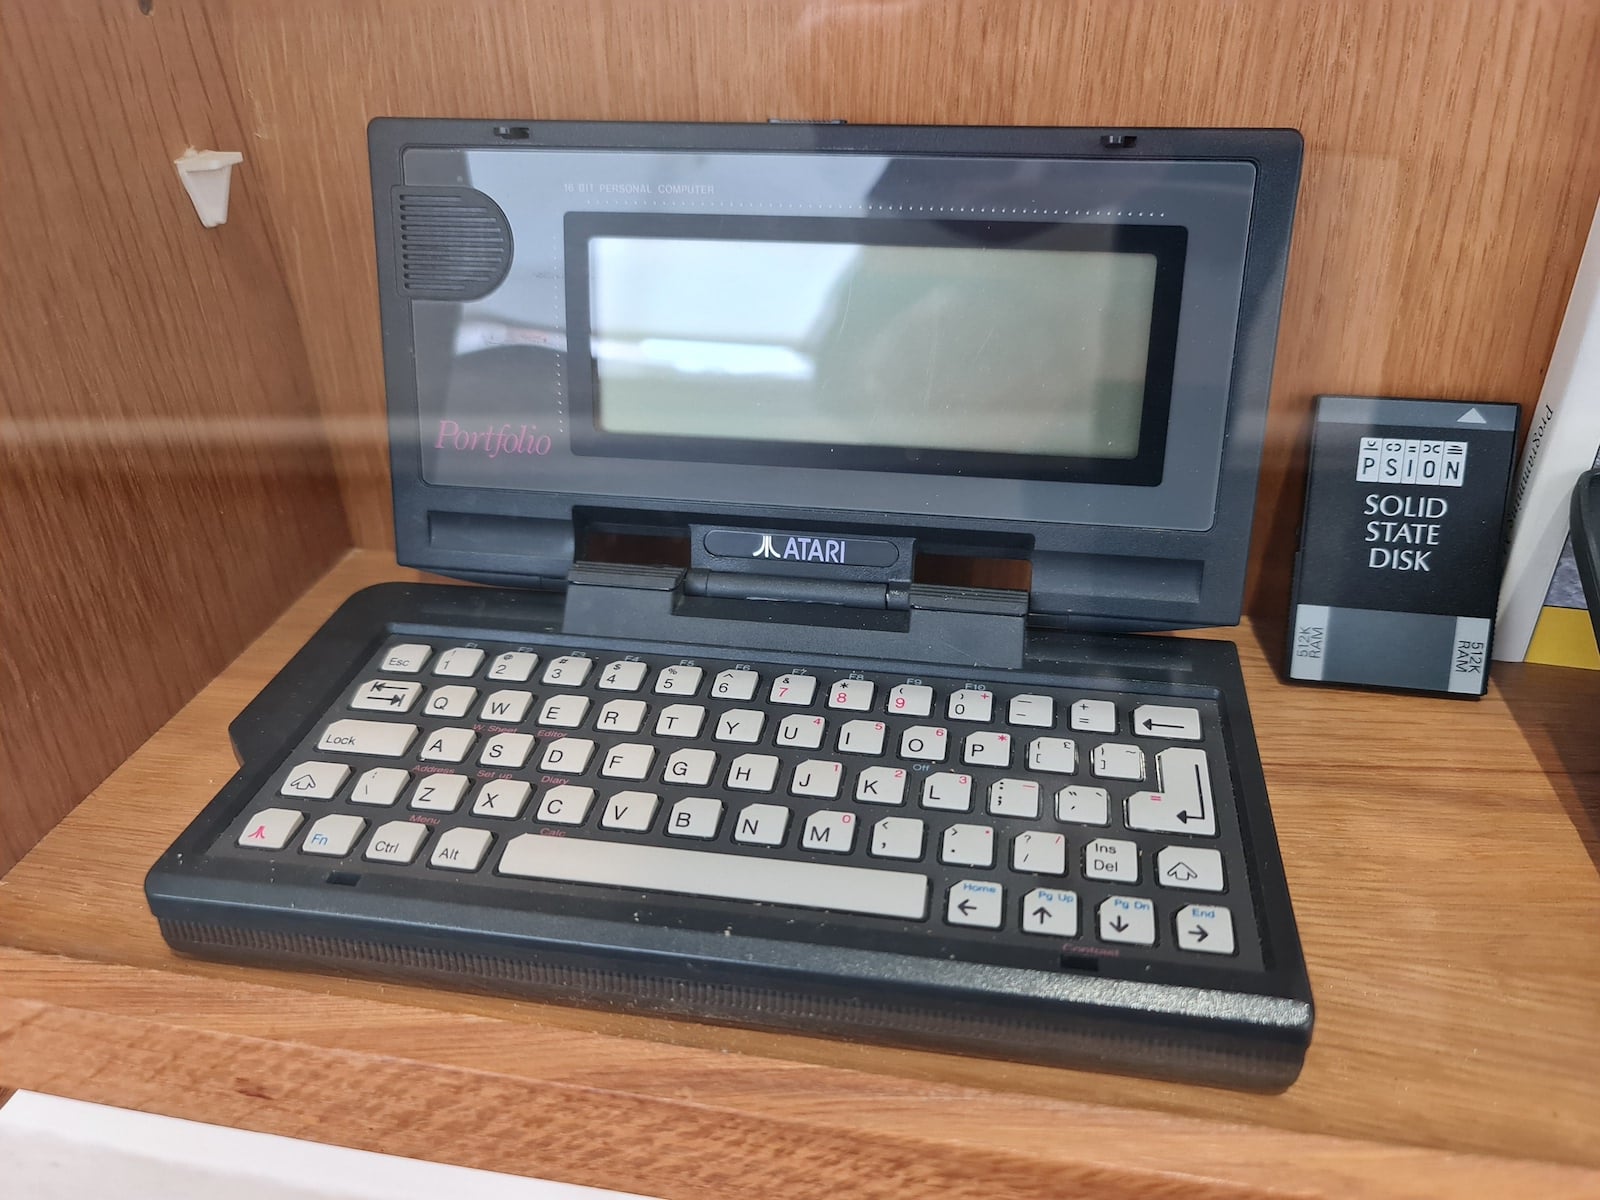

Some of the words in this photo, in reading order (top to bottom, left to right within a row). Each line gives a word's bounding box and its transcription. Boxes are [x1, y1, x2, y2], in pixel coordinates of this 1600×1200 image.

[579, 183, 594, 192] BIT
[600, 184, 652, 193] PERSONAL
[658, 184, 714, 194] COMPUTER
[435, 420, 552, 459] Portfolio
[1363, 458, 1459, 480] PSION
[1364, 494, 1448, 519] SOLID
[1365, 521, 1441, 545] STATE
[784, 537, 845, 563] ATARI
[1369, 548, 1431, 572] DISK
[1296, 625, 1311, 657] 512K
[1309, 626, 1325, 659] RAM
[389, 658, 409, 666] Esc
[1456, 639, 1470, 673] RAM
[1468, 641, 1483, 674] 512K
[496, 665, 506, 674] 2
[552, 669, 562, 678] 3
[607, 675, 616, 683] 4
[664, 679, 673, 688] 5
[719, 683, 728, 692] 6
[780, 687, 788, 697] 7
[434, 697, 448, 710] Q
[837, 693, 846, 703] 8
[896, 698, 905, 708] 9
[492, 702, 510, 715] W
[546, 707, 560, 719] E
[604, 712, 619, 724] R
[667, 717, 678, 729] T
[488, 725, 518, 733] Sheet
[538, 730, 568, 738] Editor
[727, 722, 739, 734] Y
[784, 727, 798, 739] U
[326, 735, 355, 745] Lock
[429, 739, 442, 752] A
[909, 739, 923, 752] O
[489, 745, 503, 757] S
[972, 744, 984, 756] P
[548, 750, 563, 763] D
[609, 756, 623, 768] F
[413, 764, 456, 774] Address
[673, 762, 687, 775] G
[736, 767, 750, 781] H
[912, 764, 930, 772] Off
[477, 770, 496, 778] Set
[499, 772, 512, 780] up
[541, 776, 570, 785] Diary
[799, 774, 810, 786] J
[864, 780, 878, 794] K
[930, 785, 940, 799] L
[419, 788, 435, 801] Z
[482, 793, 498, 808] X
[548, 800, 563, 814] C
[615, 806, 628, 820] V
[409, 815, 440, 825] Menu
[676, 813, 691, 827] B
[540, 828, 566, 837] Calc
[743, 819, 758, 834] N
[312, 834, 327, 845] Fn
[810, 826, 830, 842] M
[375, 841, 399, 853] Ctrl
[1096, 843, 1116, 854] Ins
[439, 848, 459, 860] Alt
[1094, 859, 1117, 872] Del
[964, 884, 995, 892] Home
[1038, 891, 1053, 901] Pg
[1059, 894, 1074, 903] Up
[1115, 899, 1129, 909] Pg
[1135, 901, 1150, 910] Dn
[1192, 908, 1215, 918] End
